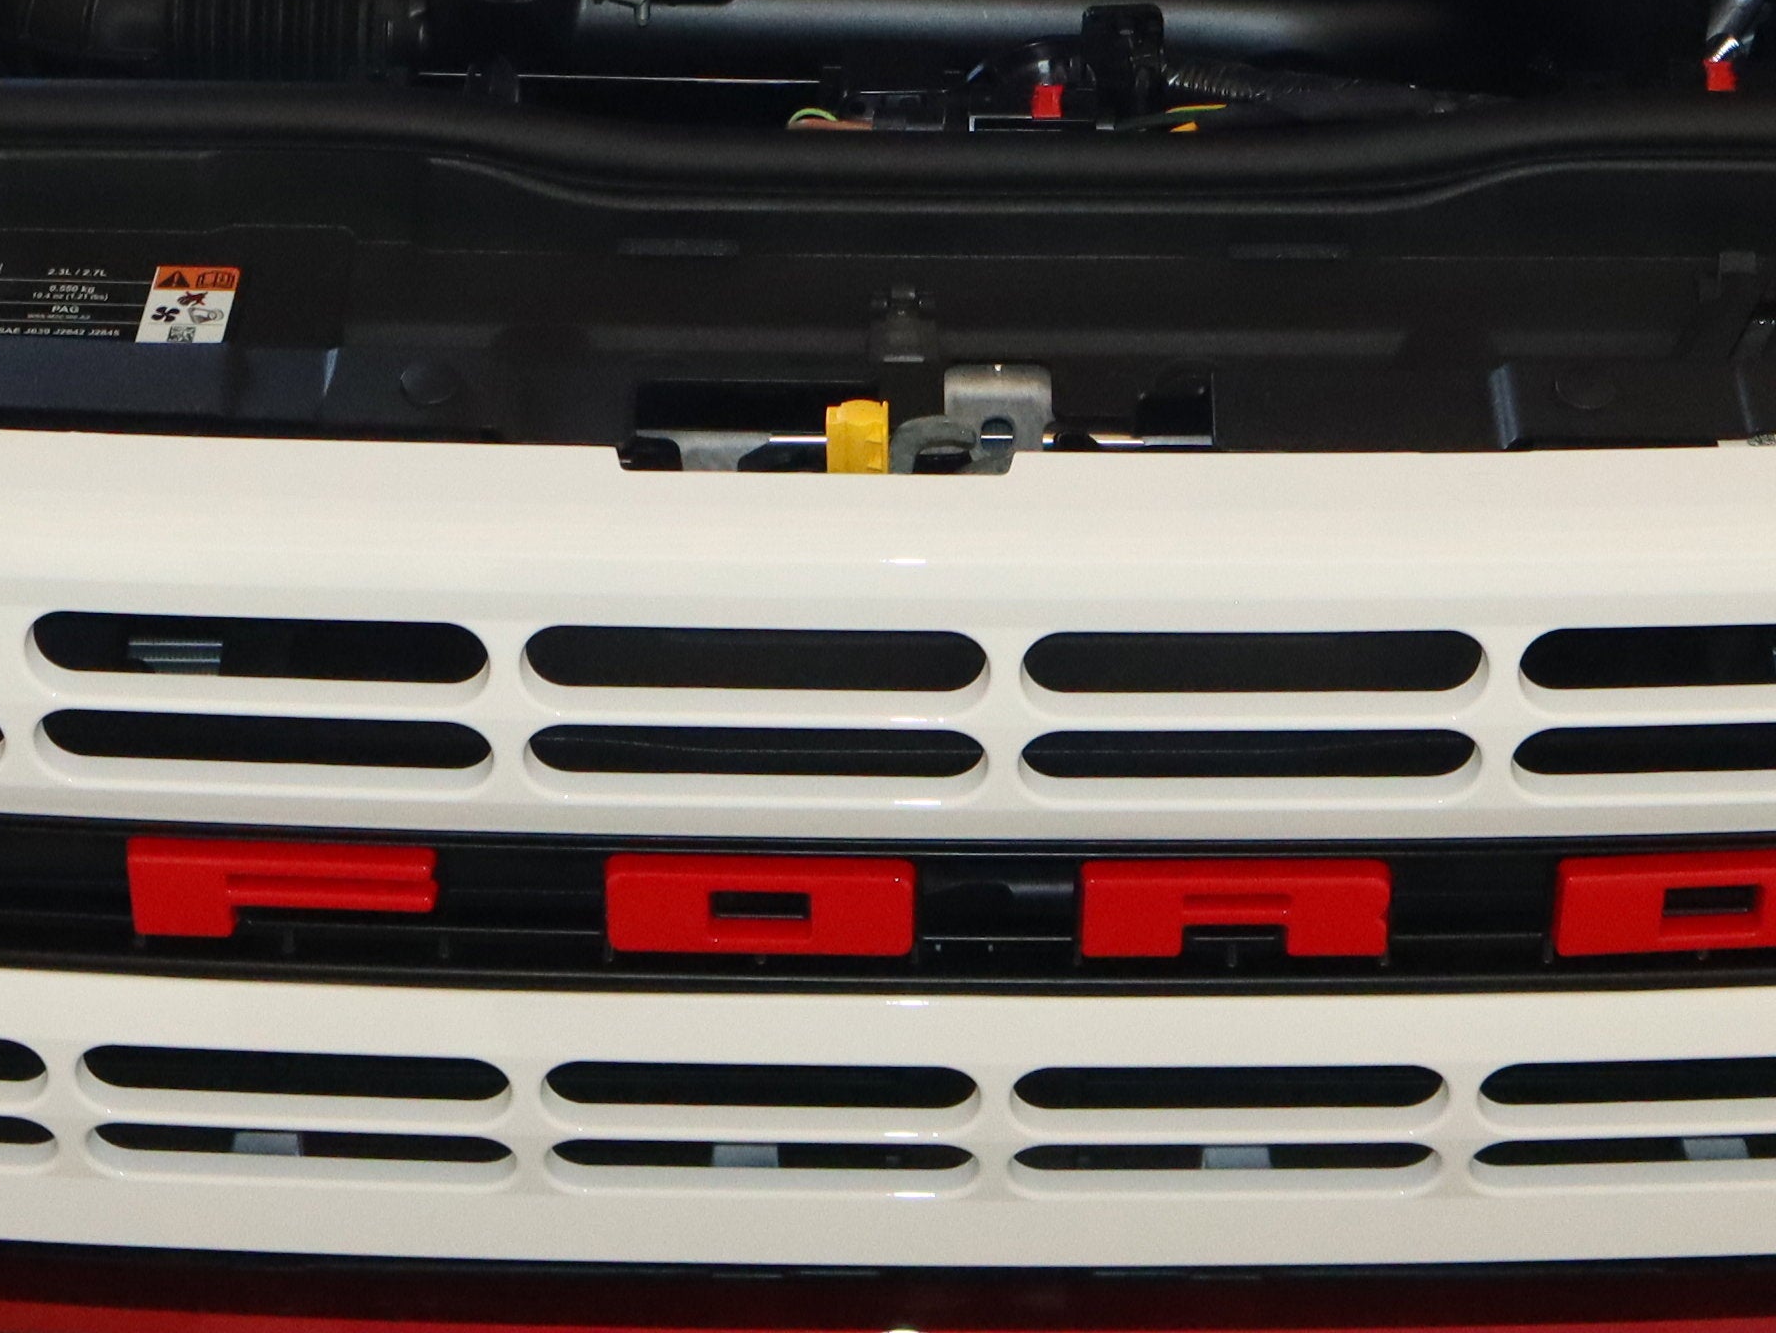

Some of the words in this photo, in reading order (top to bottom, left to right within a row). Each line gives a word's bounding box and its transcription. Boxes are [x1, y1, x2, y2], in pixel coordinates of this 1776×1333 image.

[47, 268, 72, 277] 2.3L
[82, 269, 107, 278] 2.7L
[80, 285, 96, 295] kg
[52, 305, 79, 314] PAG
